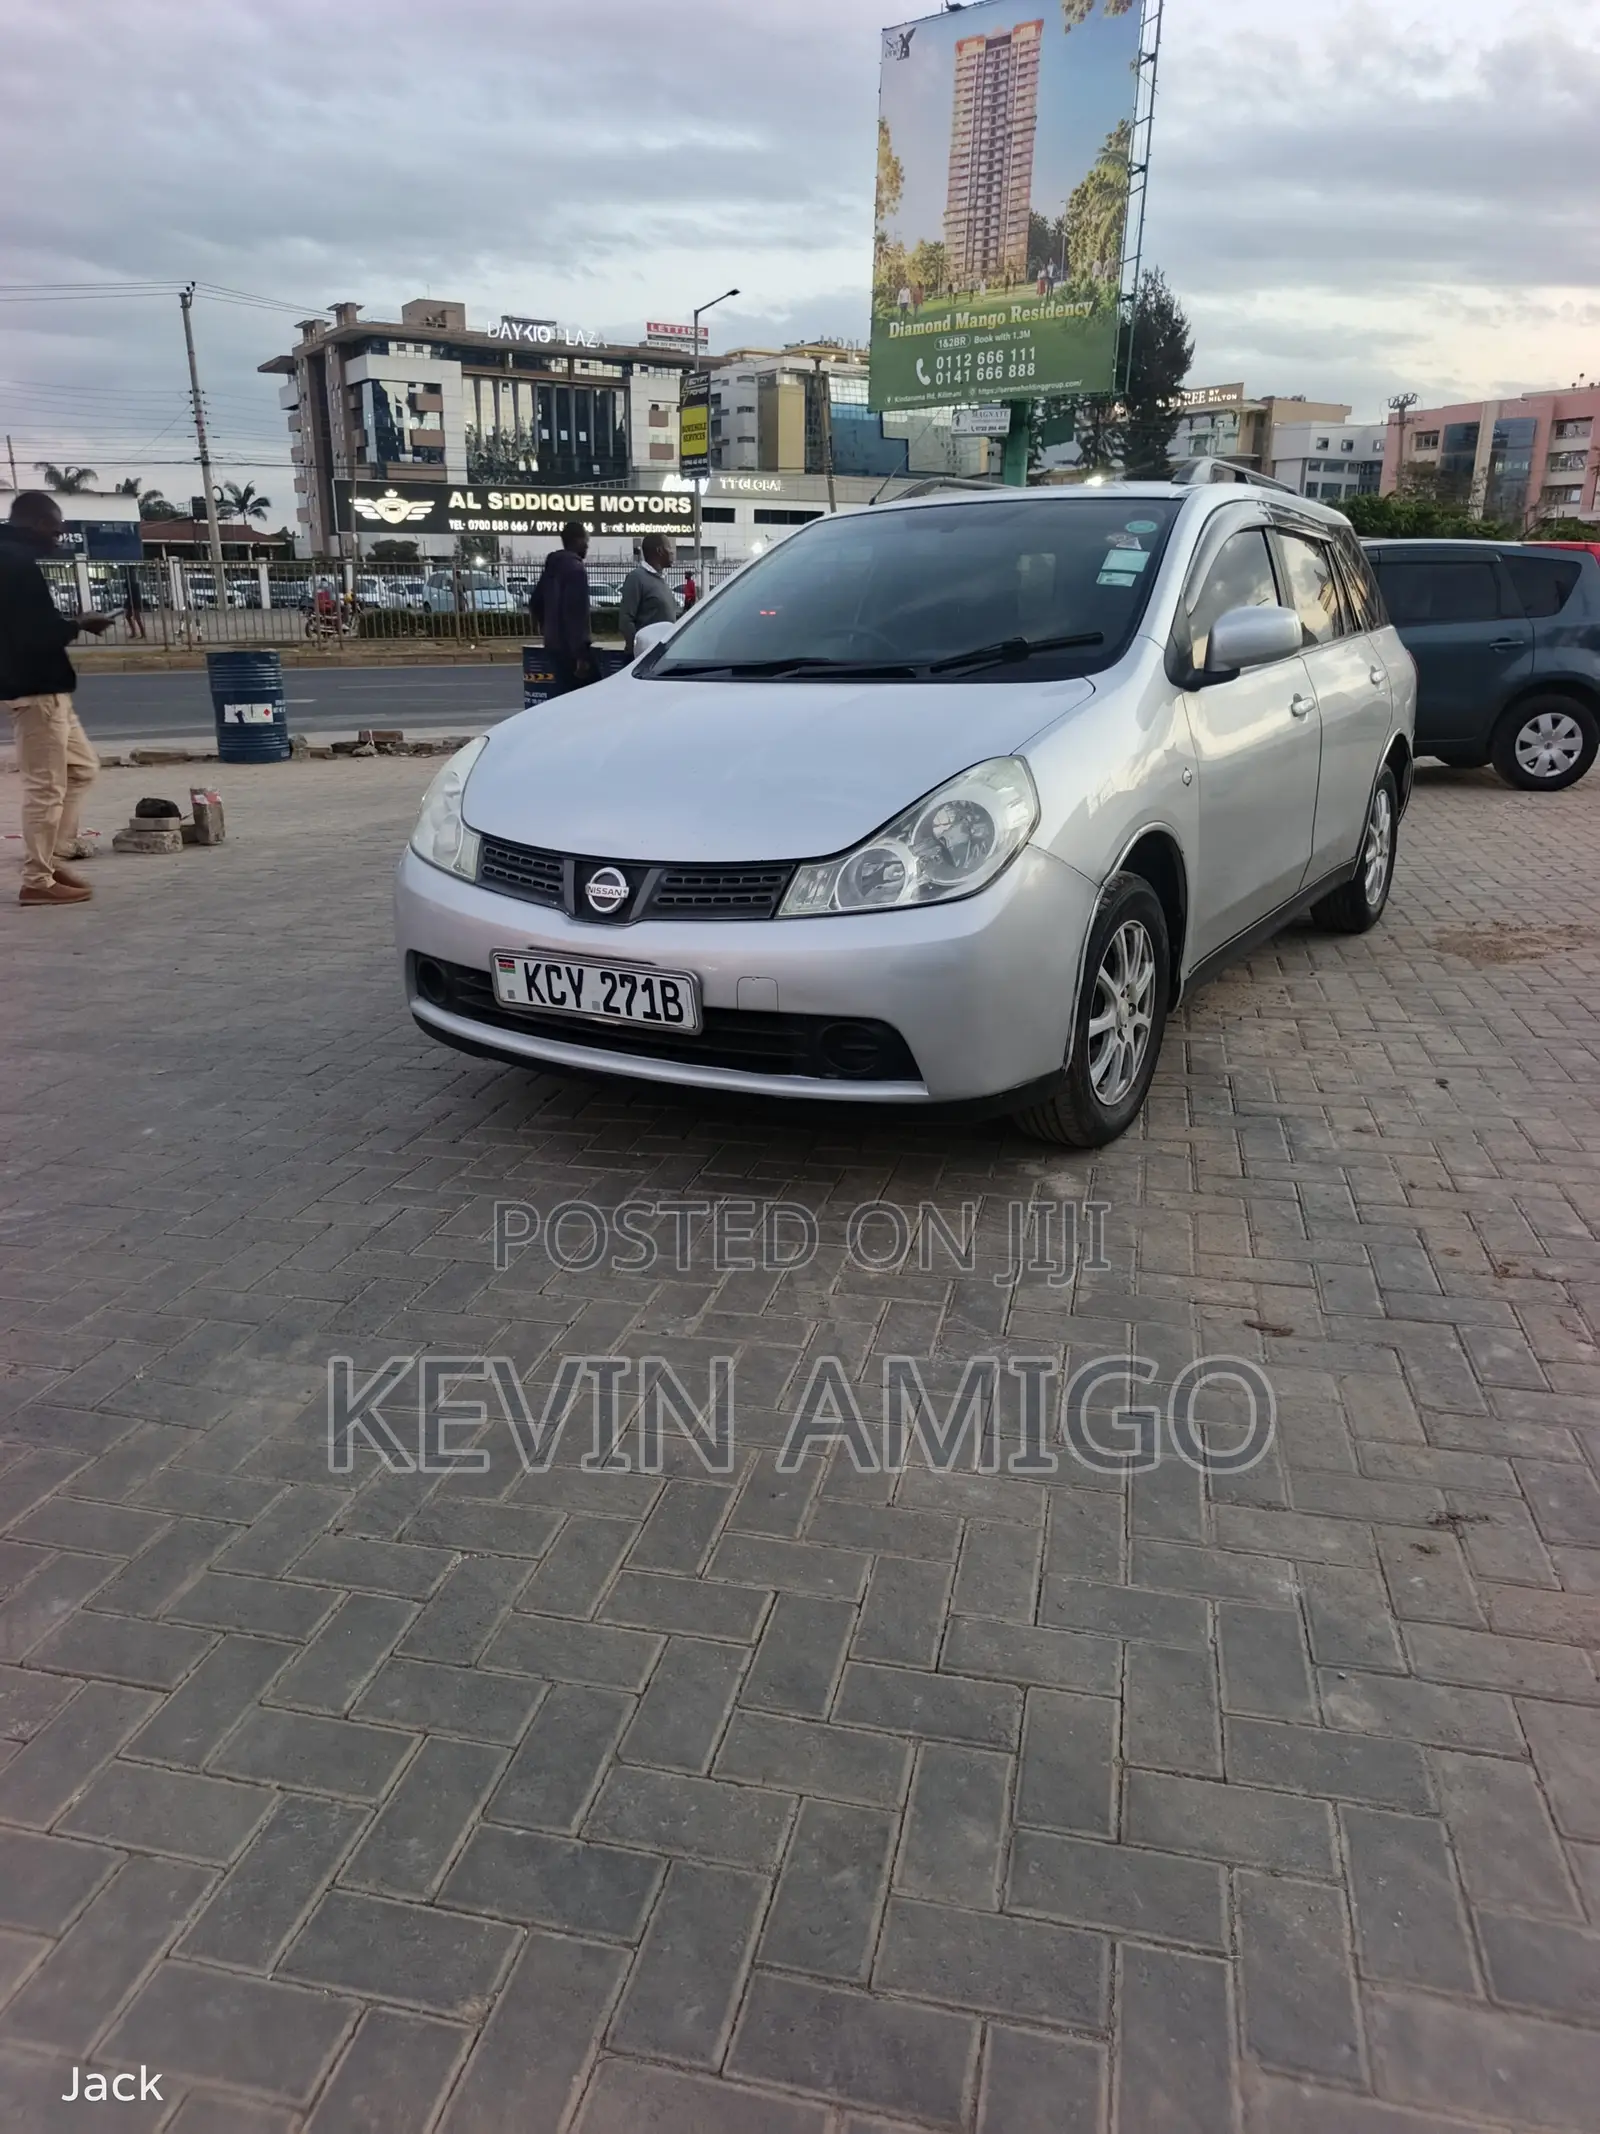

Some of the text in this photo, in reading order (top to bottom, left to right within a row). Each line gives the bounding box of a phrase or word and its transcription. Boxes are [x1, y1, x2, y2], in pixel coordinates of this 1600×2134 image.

[889, 301, 1094, 339] Diamond Mango Residency
[555, 328, 608, 349] LAZA
[938, 330, 1031, 349] 1&2BR Book with 1.3M
[936, 347, 1036, 370] 0112 666 111
[935, 362, 1036, 385] 0141 666 888
[448, 491, 482, 509] AL
[600, 495, 692, 513] MOTORS
[468, 520, 490, 531] 0700
[588, 885, 622, 896] NISSAN
[524, 962, 584, 1009] KCY
[600, 971, 684, 1024] 271B
